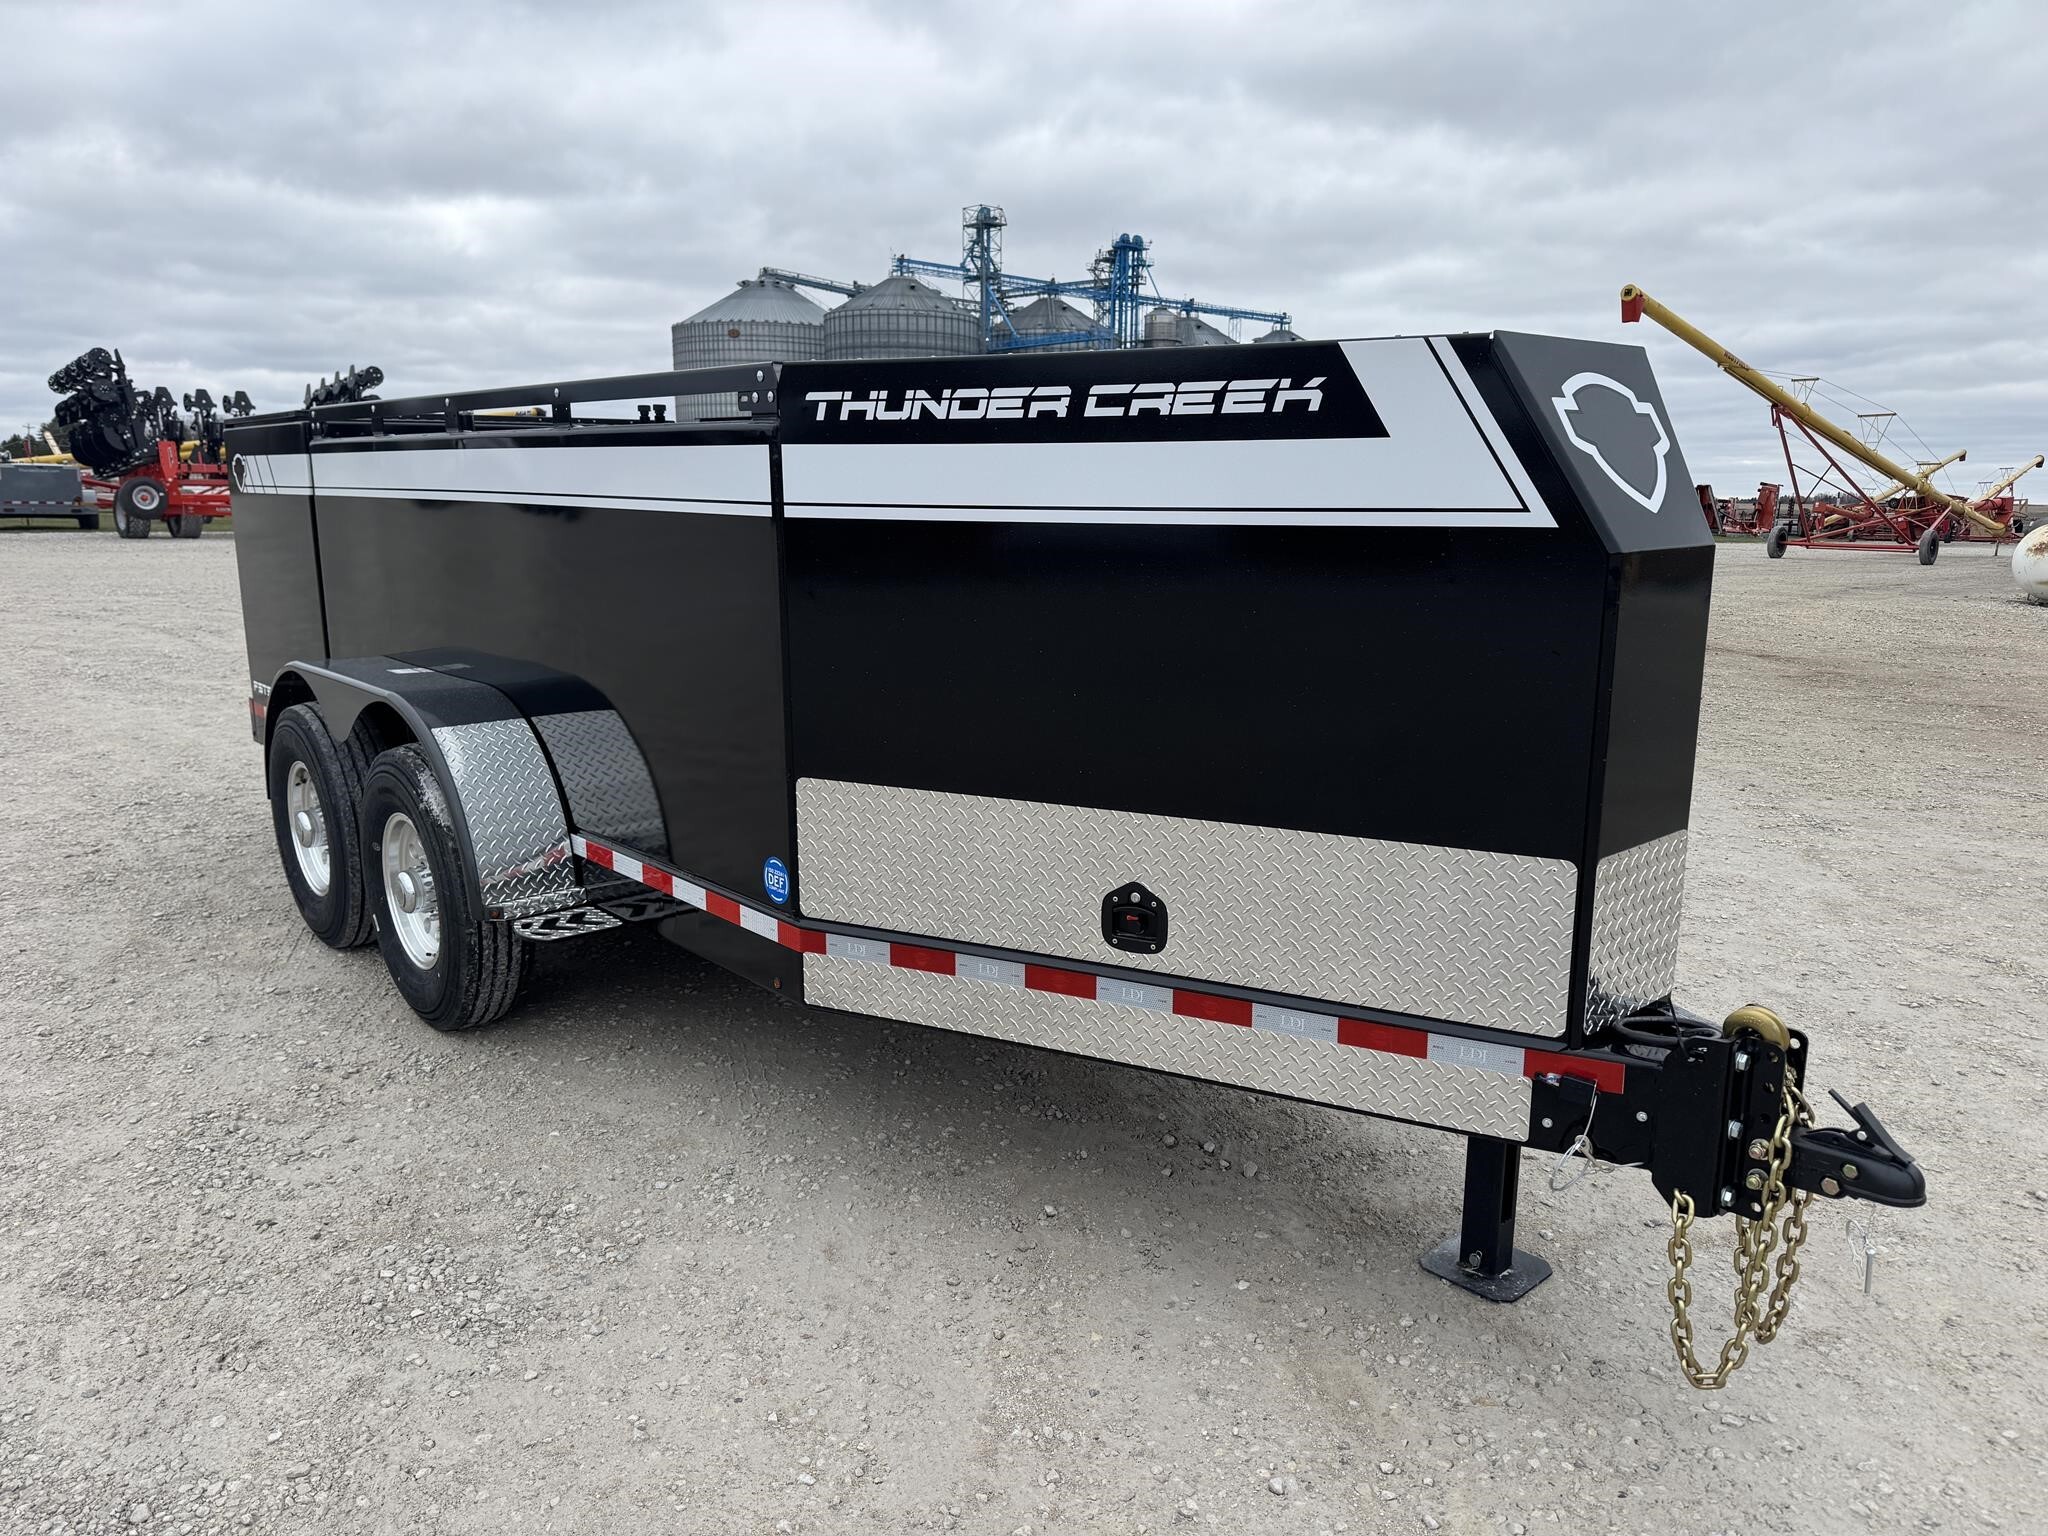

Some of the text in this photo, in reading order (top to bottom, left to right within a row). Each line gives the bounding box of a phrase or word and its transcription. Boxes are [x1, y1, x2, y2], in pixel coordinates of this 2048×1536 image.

[805, 377, 1328, 421] THUNDER CREEK
[768, 873, 785, 888] DEF
